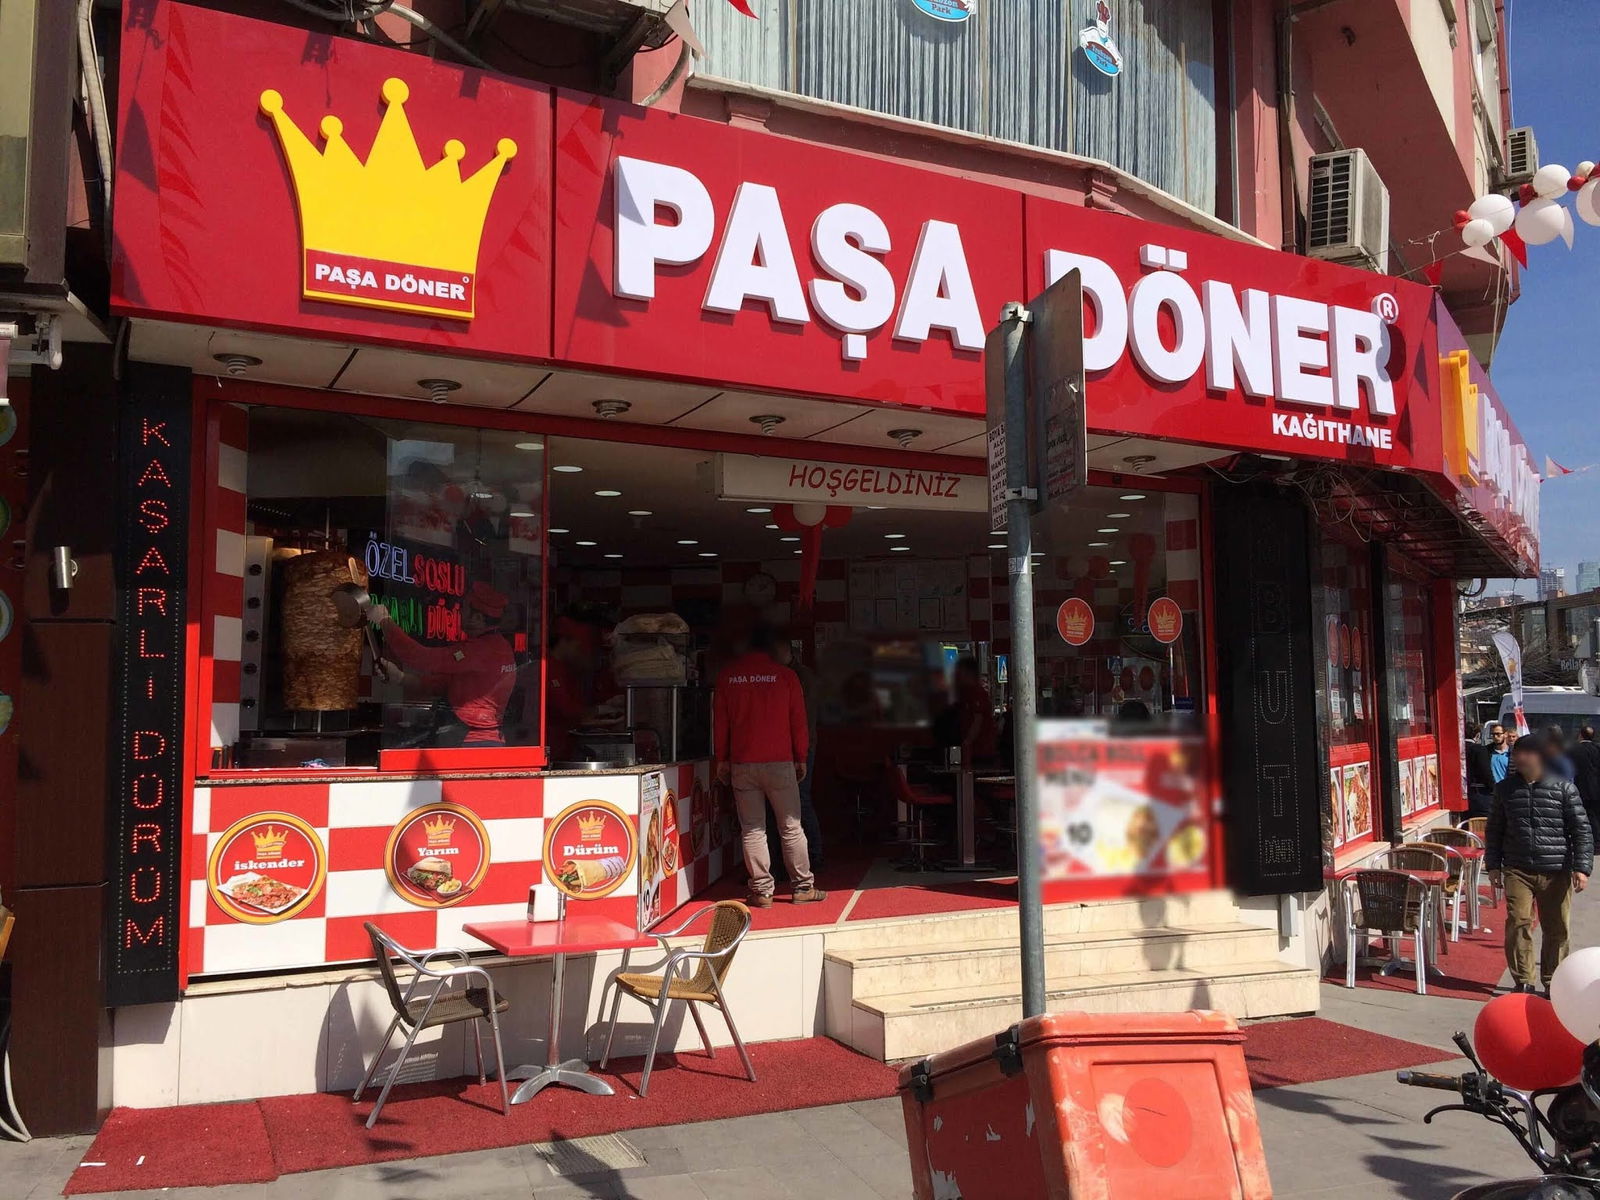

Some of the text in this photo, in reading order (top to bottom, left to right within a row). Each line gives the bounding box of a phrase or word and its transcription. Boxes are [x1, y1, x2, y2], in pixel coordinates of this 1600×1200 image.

[613, 155, 986, 362] PAŞA
[315, 263, 466, 301] PAŞA DÖNER
[1271, 412, 1393, 450] KAĞITHANE
[788, 464, 961, 499] HOŞGELDİNİZ
[365, 531, 415, 585] ÖZEL
[233, 858, 305, 871] iskender
[417, 845, 460, 857] Yarım
[563, 843, 619, 857] Dürüm
